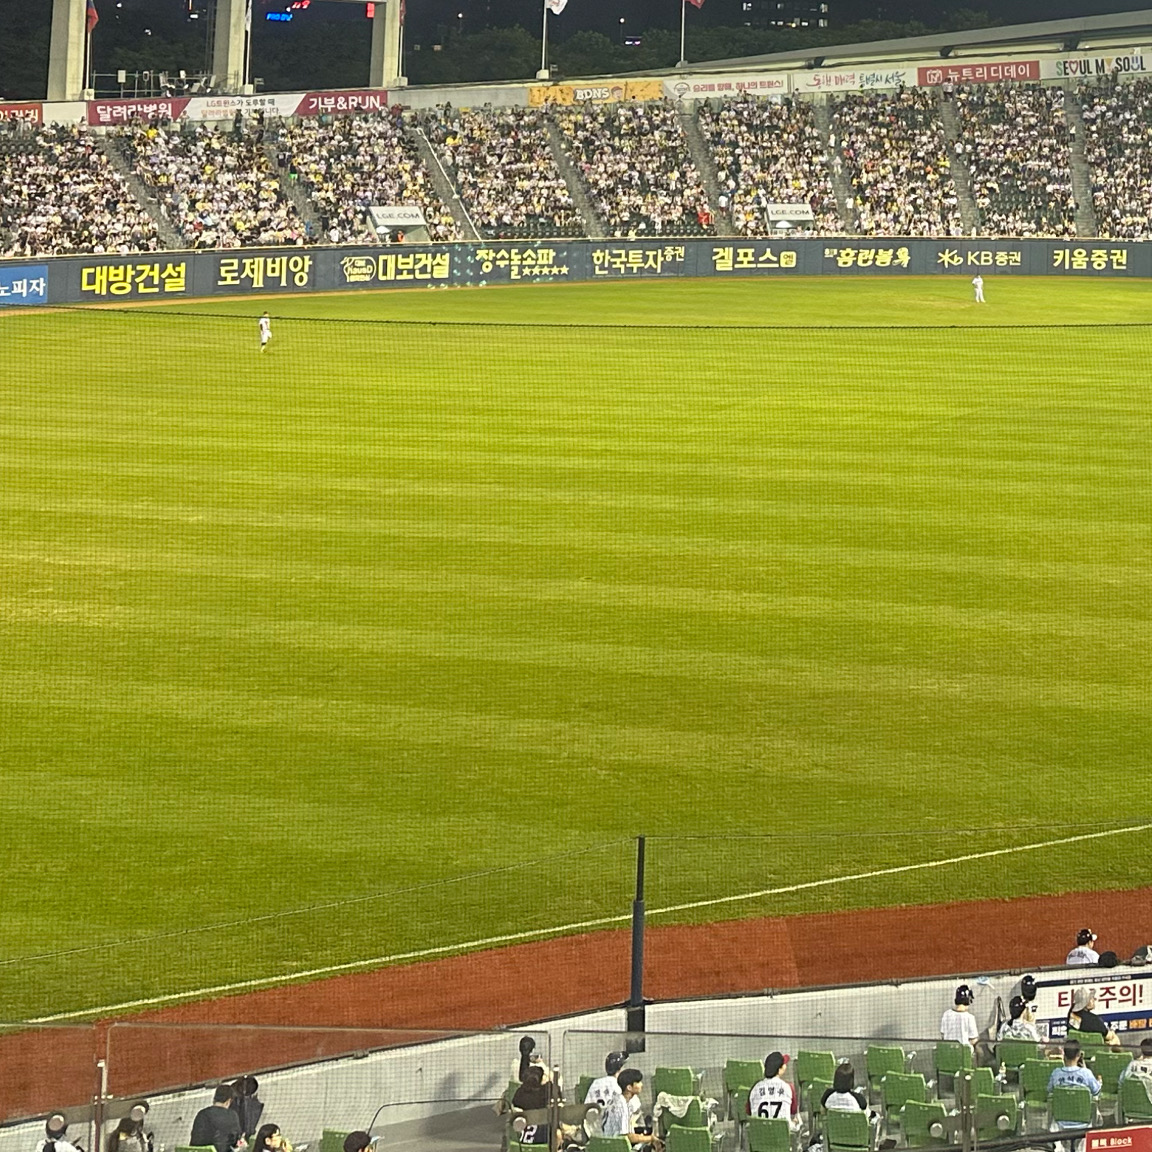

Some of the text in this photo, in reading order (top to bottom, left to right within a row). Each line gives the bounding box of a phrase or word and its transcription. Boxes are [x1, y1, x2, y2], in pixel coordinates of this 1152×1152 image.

[947, 63, 1030, 81] 뉴트리디데이
[1115, 56, 1146, 72] SOUL
[574, 88, 610, 101] BDNS
[378, 253, 450, 281] 대보건설
[475, 248, 556, 280] 장수돌소파
[592, 246, 685, 276] 한국투자증권
[712, 247, 780, 271] 겔포스
[967, 251, 1021, 266] KB증권
[1053, 249, 1127, 270] 키움증권
[81, 262, 187, 296] 대방건설
[217, 254, 313, 288] 로제비앙
[1058, 983, 1144, 1008] 타주의!
[757, 1101, 782, 1119] 67
[1110, 1136, 1132, 1146] Block
